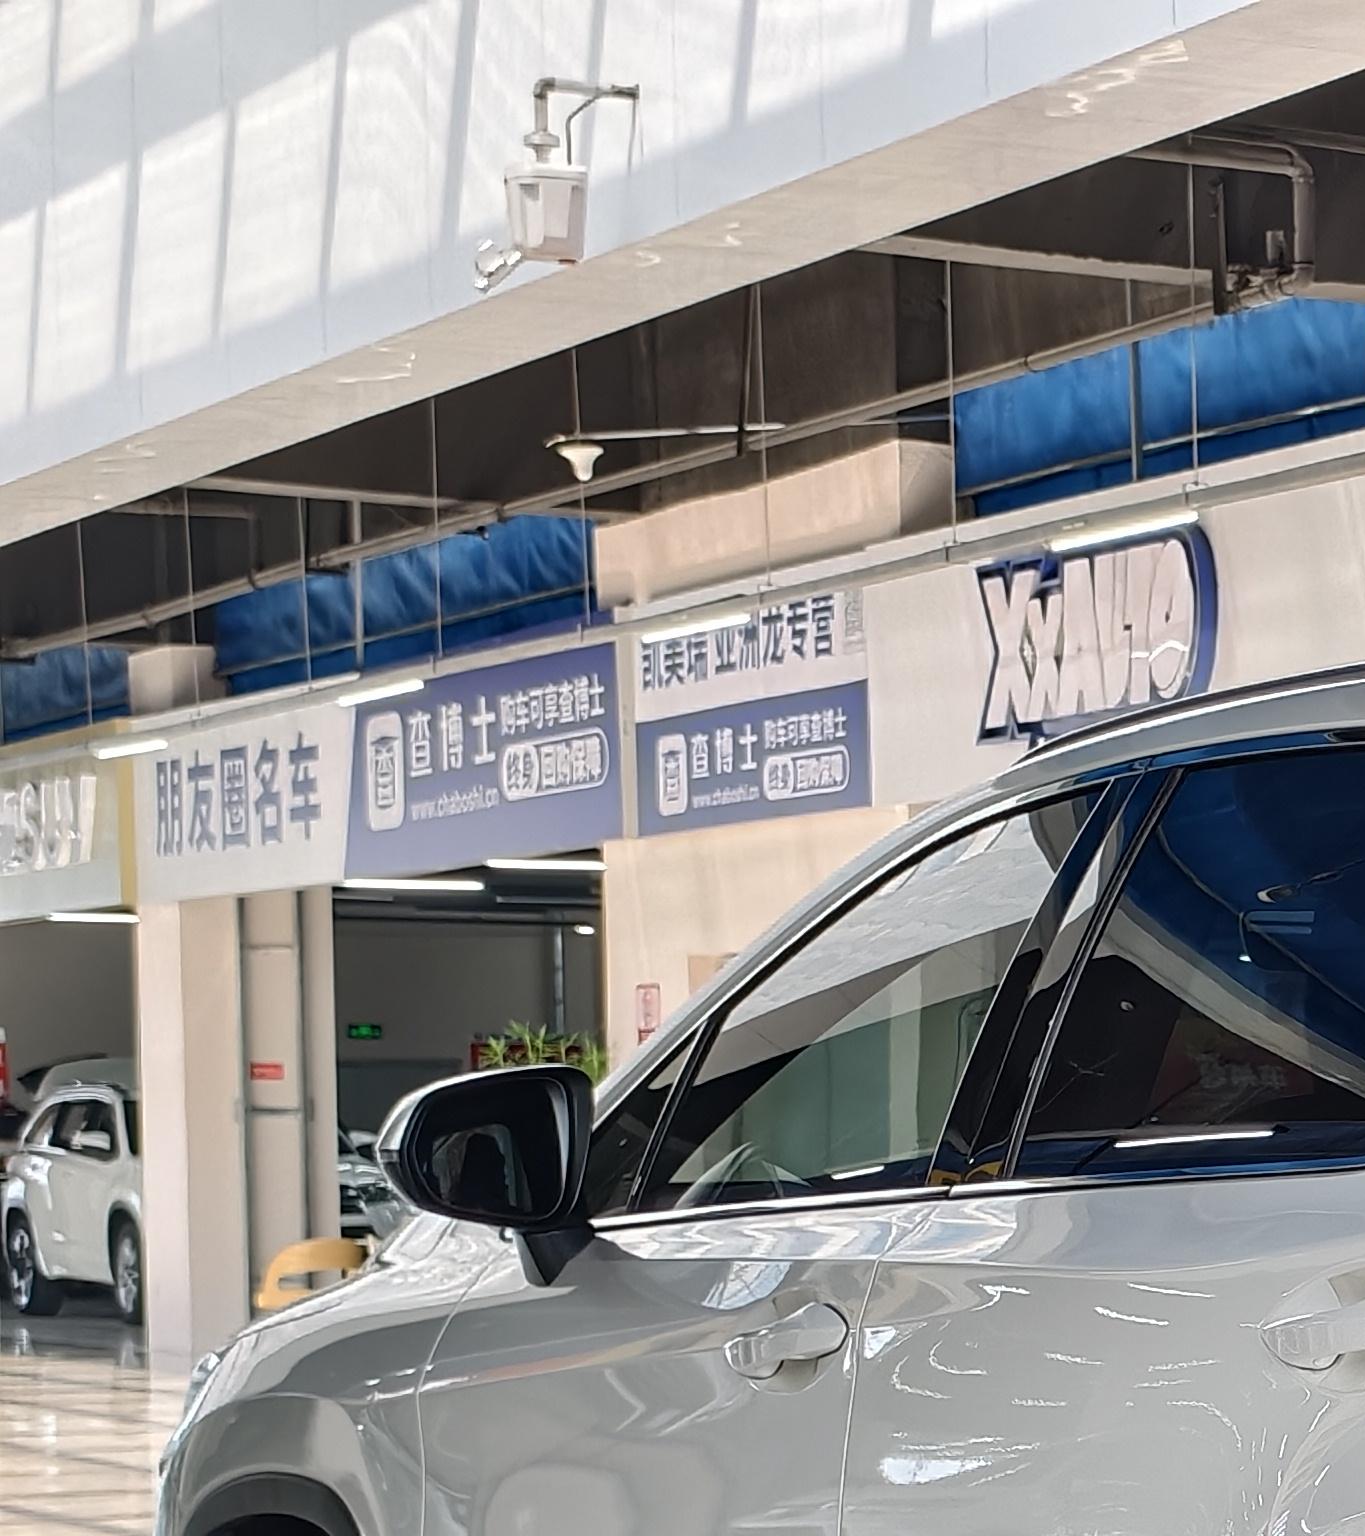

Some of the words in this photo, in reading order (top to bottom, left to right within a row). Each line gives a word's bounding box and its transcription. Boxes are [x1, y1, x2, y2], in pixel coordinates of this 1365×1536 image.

[500, 672, 606, 736] 购车可享查博士
[763, 706, 848, 750] 购车可享查博士
[408, 695, 497, 778] 查博士
[690, 723, 759, 780] 查博士
[155, 730, 322, 857] 朋友圈名车
